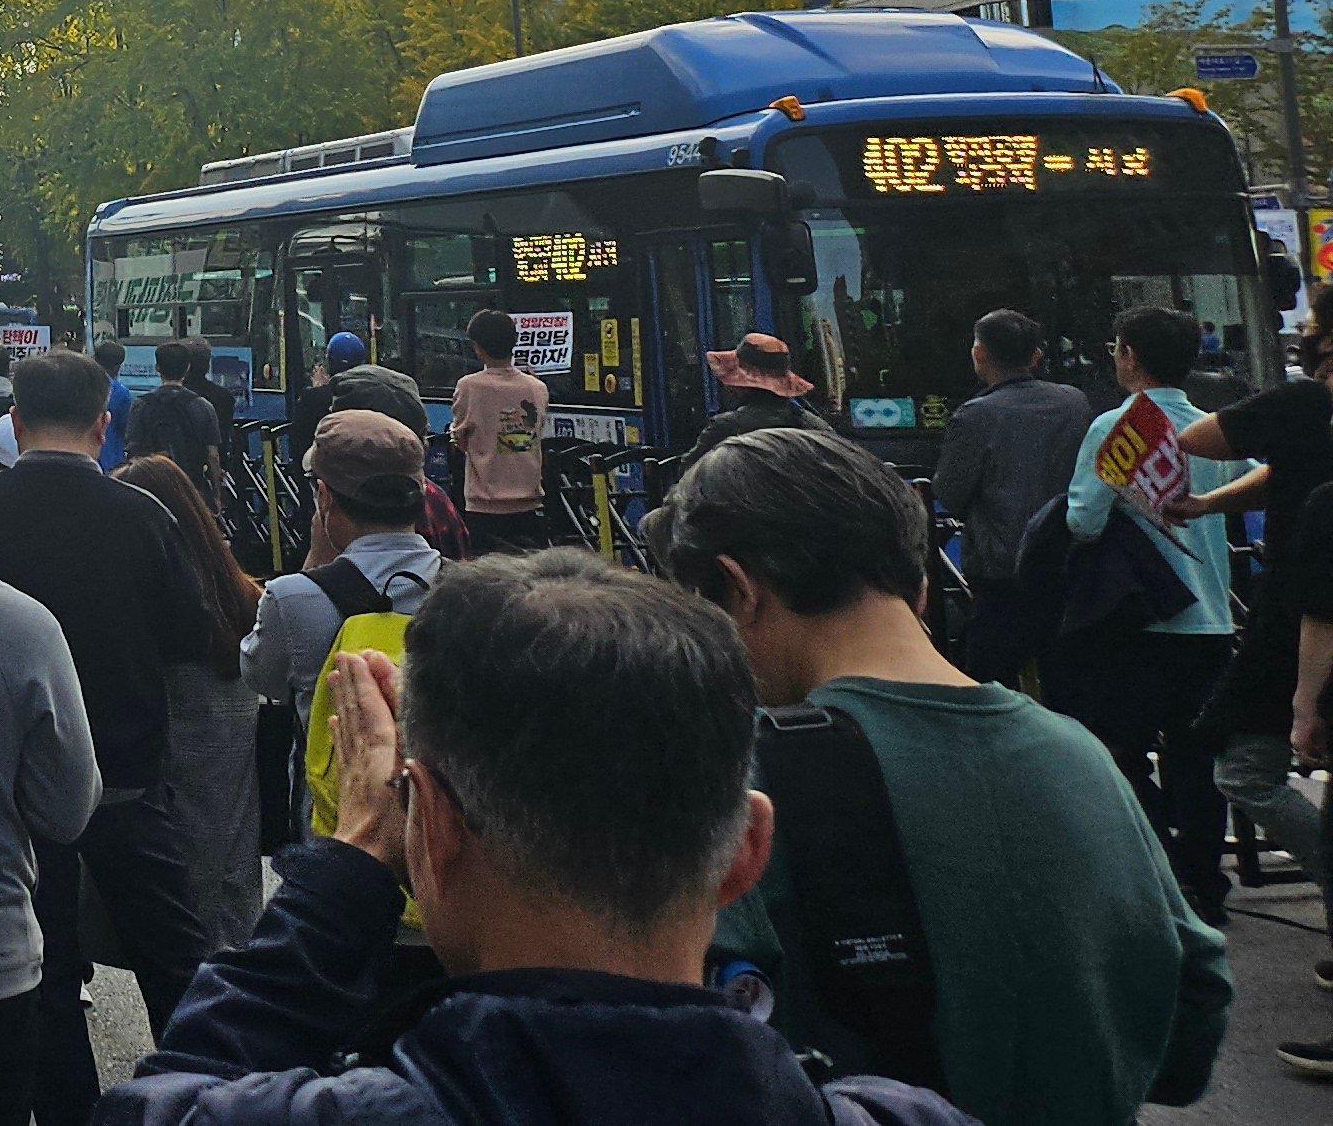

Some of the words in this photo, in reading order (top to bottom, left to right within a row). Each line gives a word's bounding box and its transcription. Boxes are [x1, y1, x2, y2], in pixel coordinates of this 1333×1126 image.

[2, 330, 39, 346] 탄핵이
[515, 329, 569, 347] 희일당
[511, 347, 569, 367] 멸하자!
